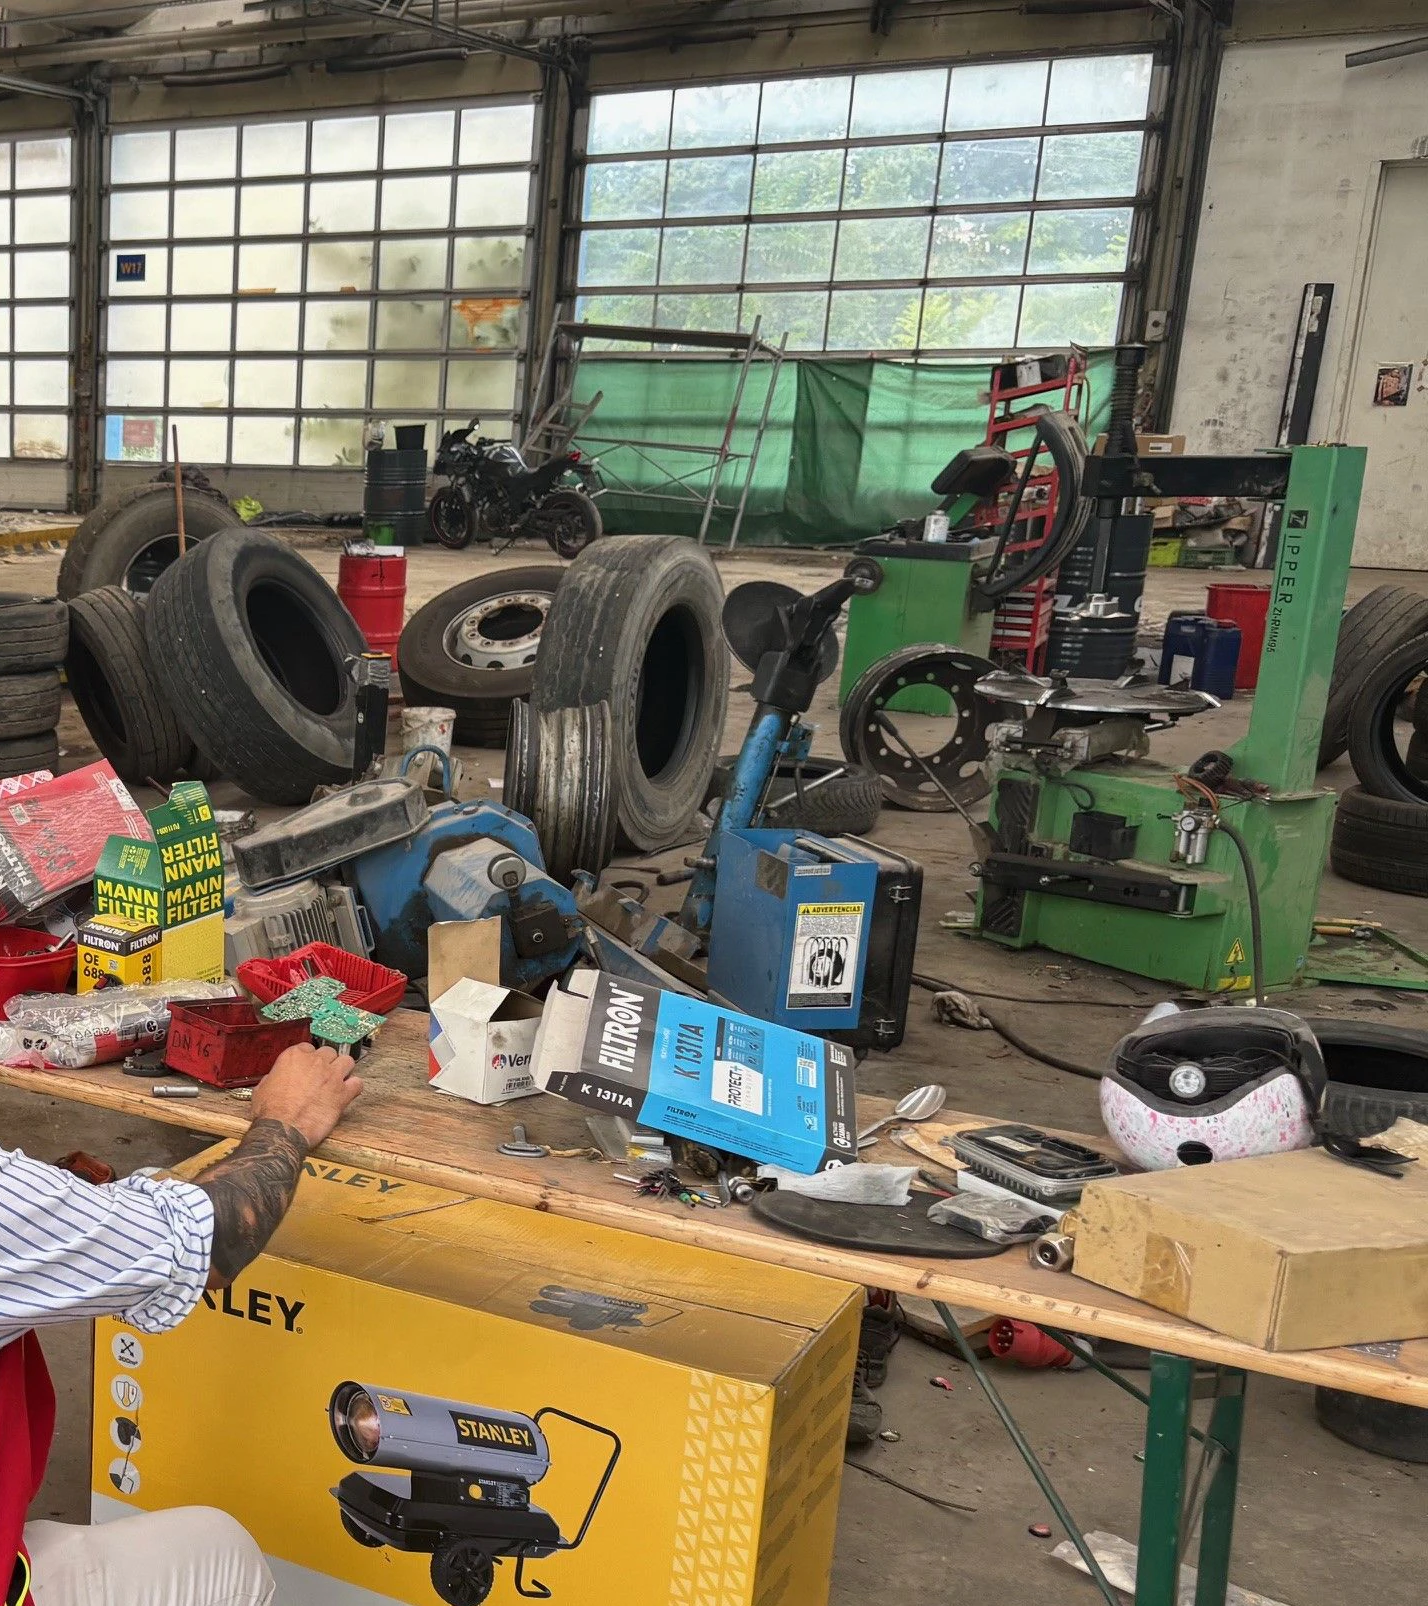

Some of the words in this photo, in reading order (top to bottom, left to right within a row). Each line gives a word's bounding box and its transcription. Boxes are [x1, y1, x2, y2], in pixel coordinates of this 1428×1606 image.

[161, 832, 219, 864] FILTER
[164, 850, 221, 882] MANN
[97, 879, 158, 908] MANN
[167, 874, 222, 907] MANN
[98, 896, 159, 925] FILTER
[167, 892, 222, 925] FILTER
[812, 905, 861, 914] ADVERTENCIAS
[83, 934, 121, 951] FILTRON
[130, 933, 160, 951] FILTRON
[83, 952, 100, 966] OE
[172, 1028, 191, 1051] DN
[598, 990, 644, 1073] FILTRON
[674, 1022, 705, 1061] 1311A
[673, 1063, 701, 1081] K
[580, 1083, 591, 1095] K
[596, 1086, 634, 1108] 1311A
[666, 1105, 696, 1119] FILTRON
[457, 1418, 532, 1447] STANLEY
